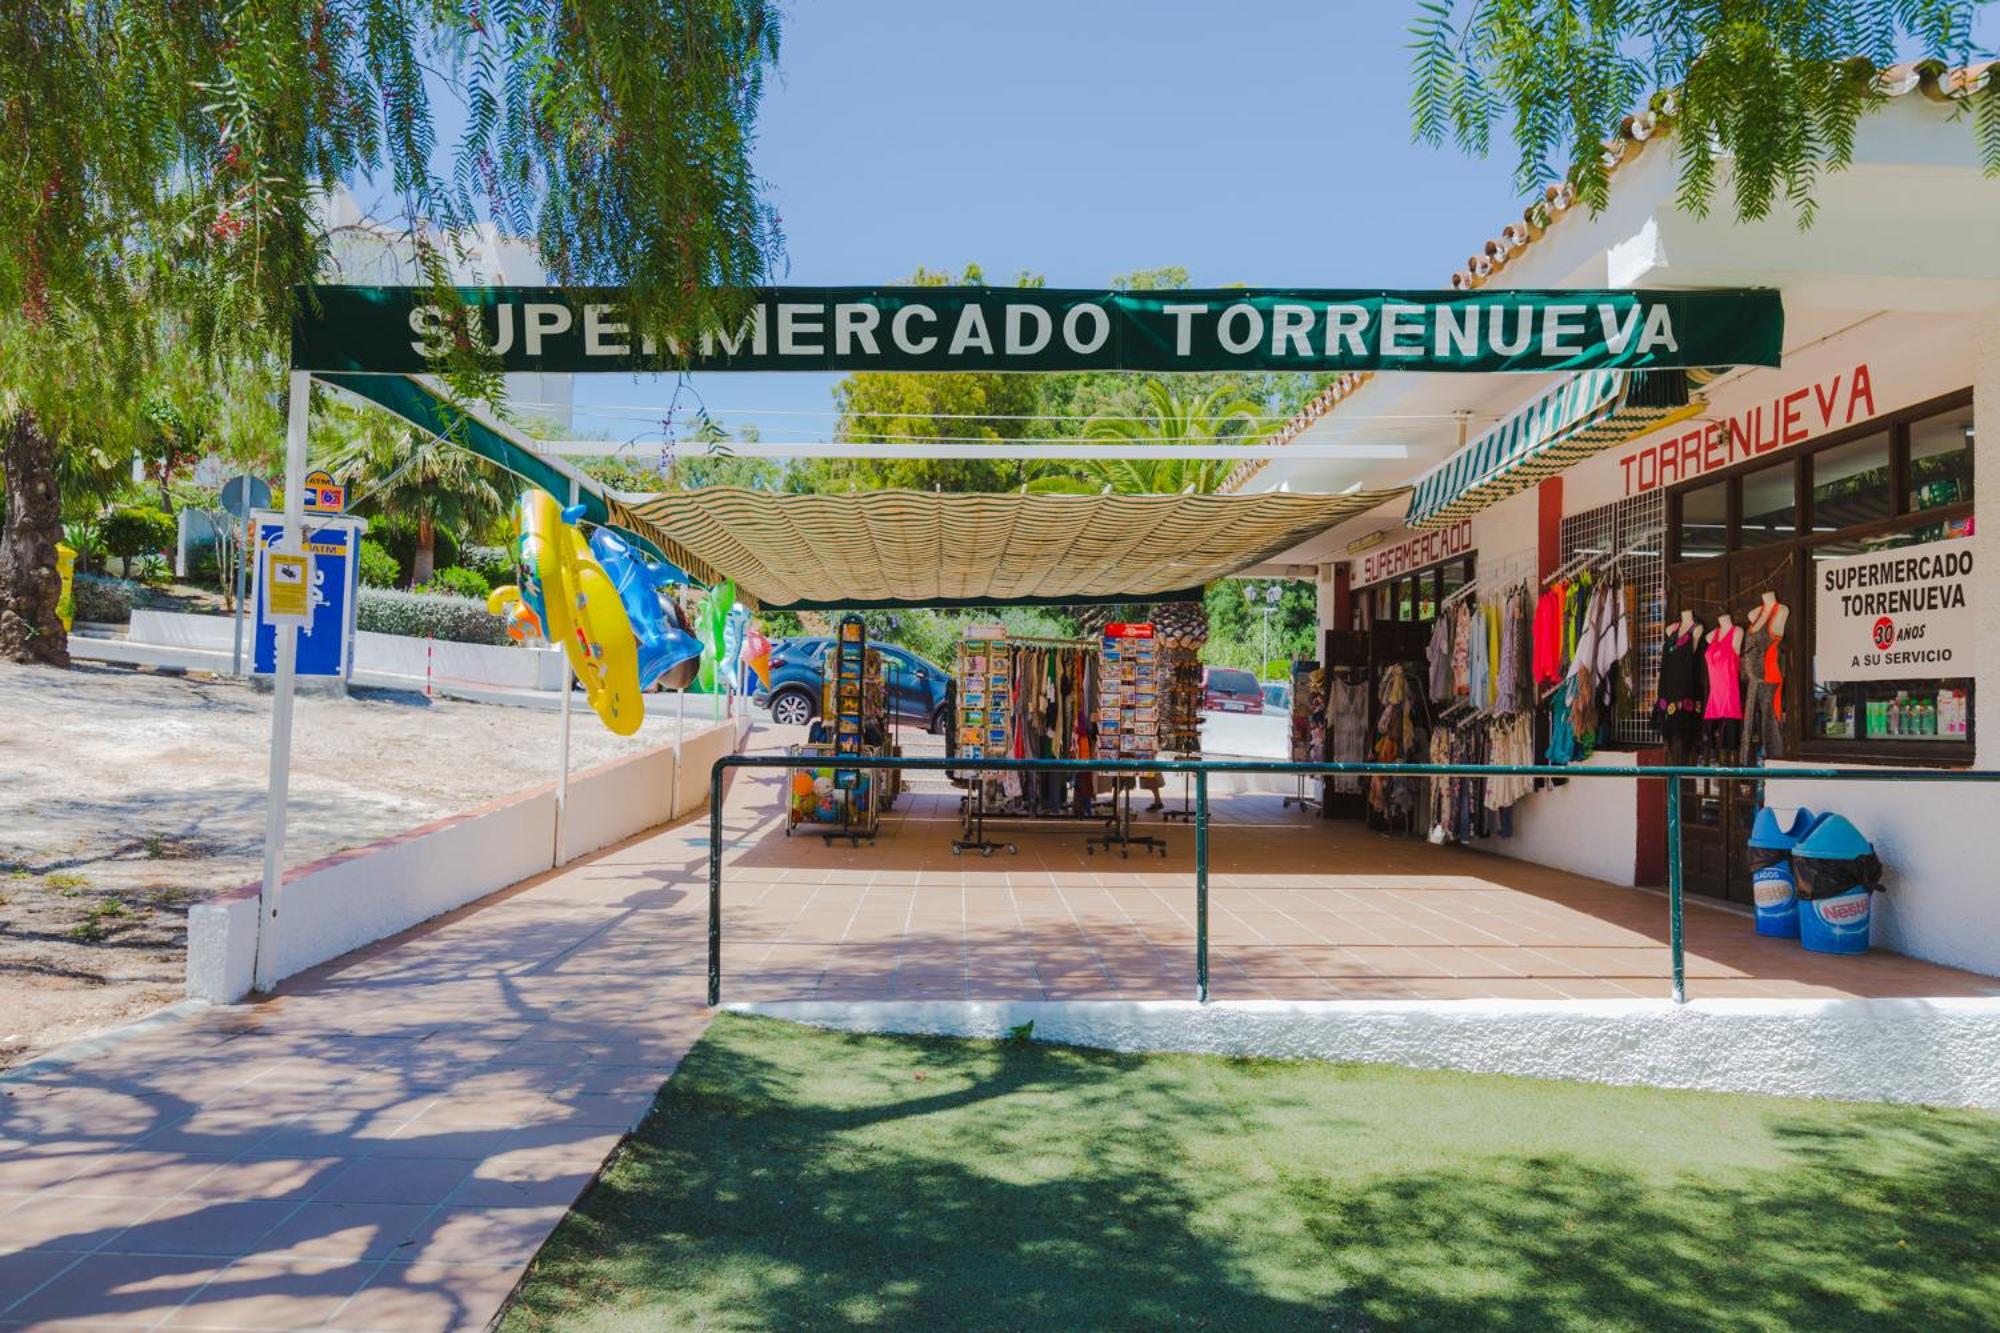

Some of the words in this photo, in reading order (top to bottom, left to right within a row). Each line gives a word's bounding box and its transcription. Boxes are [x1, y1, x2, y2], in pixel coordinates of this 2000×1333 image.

[408, 302, 1111, 357] SUPEMERCADO
[1163, 303, 1678, 357] TORRENUEVA
[1620, 364, 1875, 496] TORRENUEVA
[1364, 519, 1472, 583] SUPERMERCADO
[1825, 550, 1974, 591] SUPERMERCADO
[1842, 583, 1966, 617] TORRENUEVA
[1875, 624, 1894, 644] 30
[1896, 623, 1926, 642] AÑOS
[1851, 655, 1860, 667] A
[1864, 654, 1881, 666] SU
[1885, 648, 1953, 665] SERVICIO
